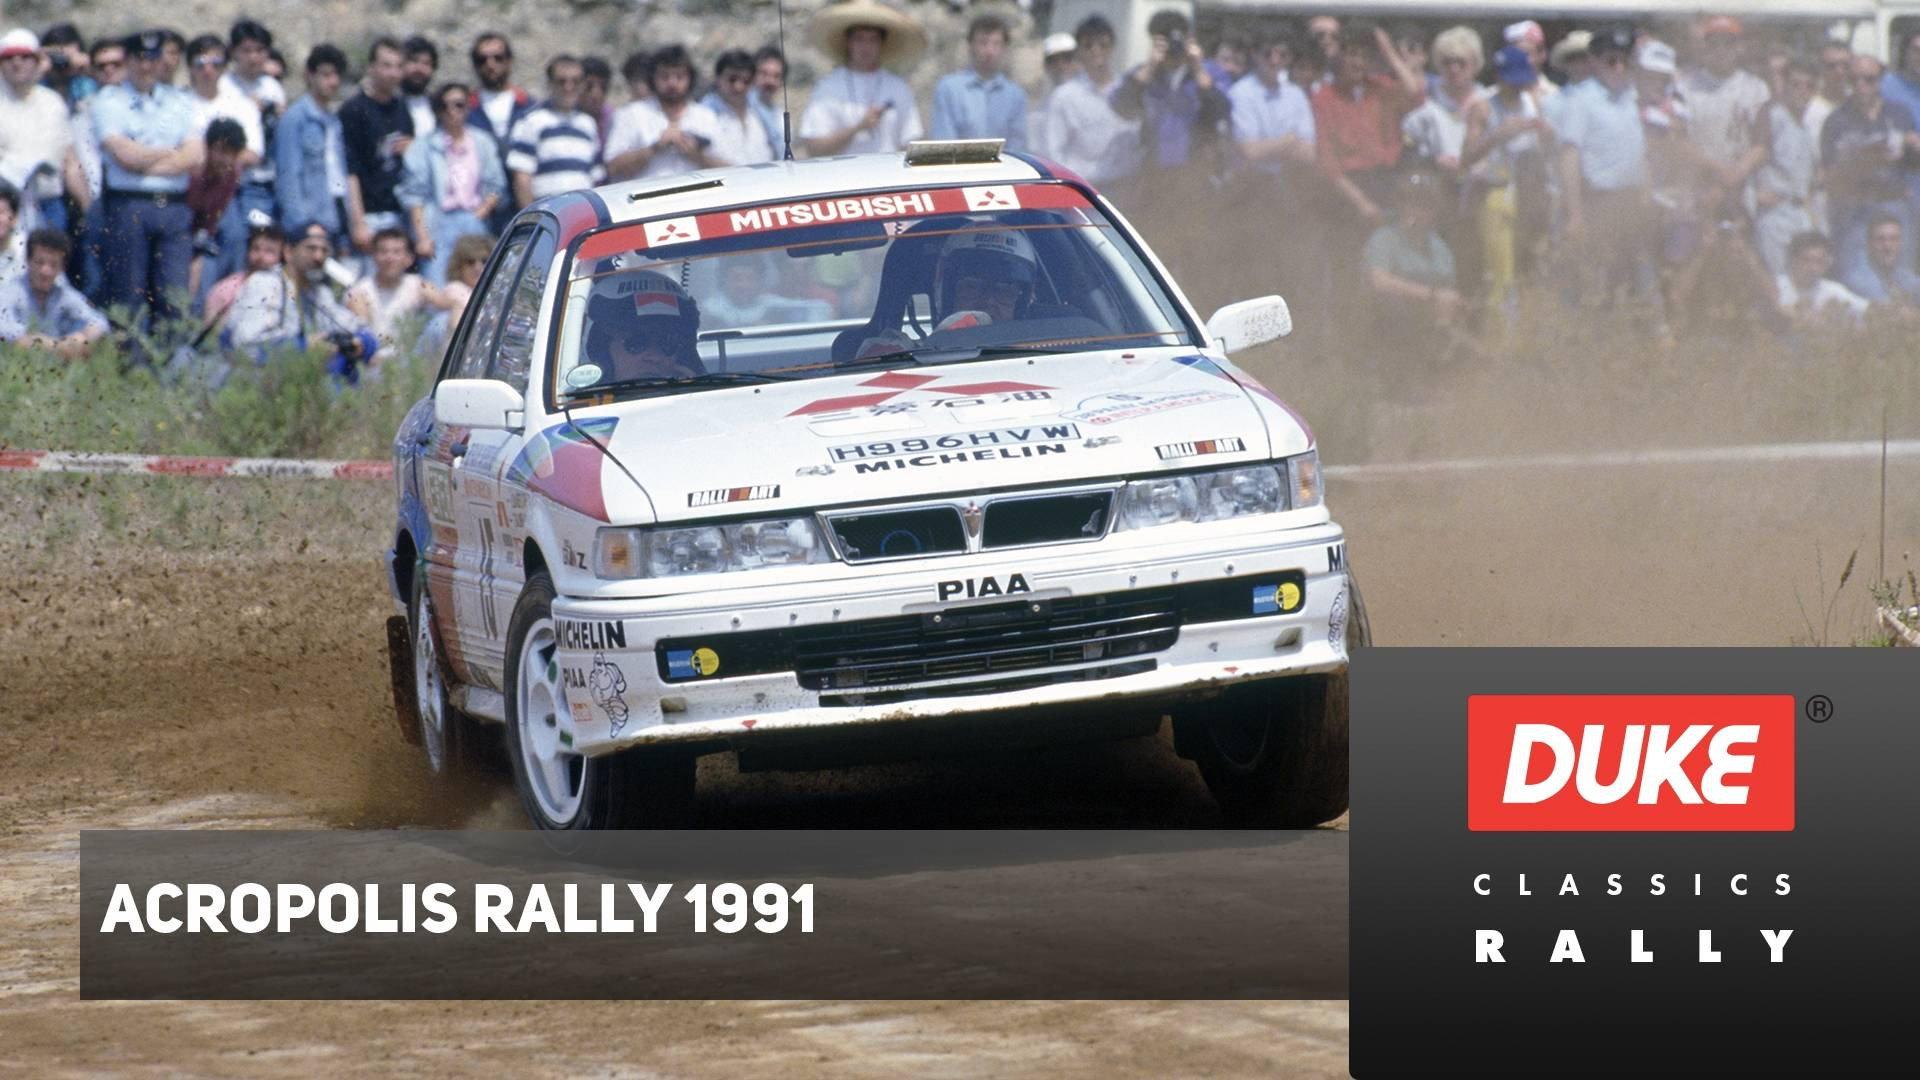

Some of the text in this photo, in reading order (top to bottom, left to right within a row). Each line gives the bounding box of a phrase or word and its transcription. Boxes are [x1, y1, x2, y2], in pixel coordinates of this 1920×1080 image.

[729, 193, 936, 233] MITSUBISHI
[834, 425, 1070, 461] H996HVW
[854, 443, 1067, 475] MICHELIN
[938, 573, 1031, 601] PIAA
[555, 619, 627, 649] MICHELIN
[563, 667, 586, 689] PIAA
